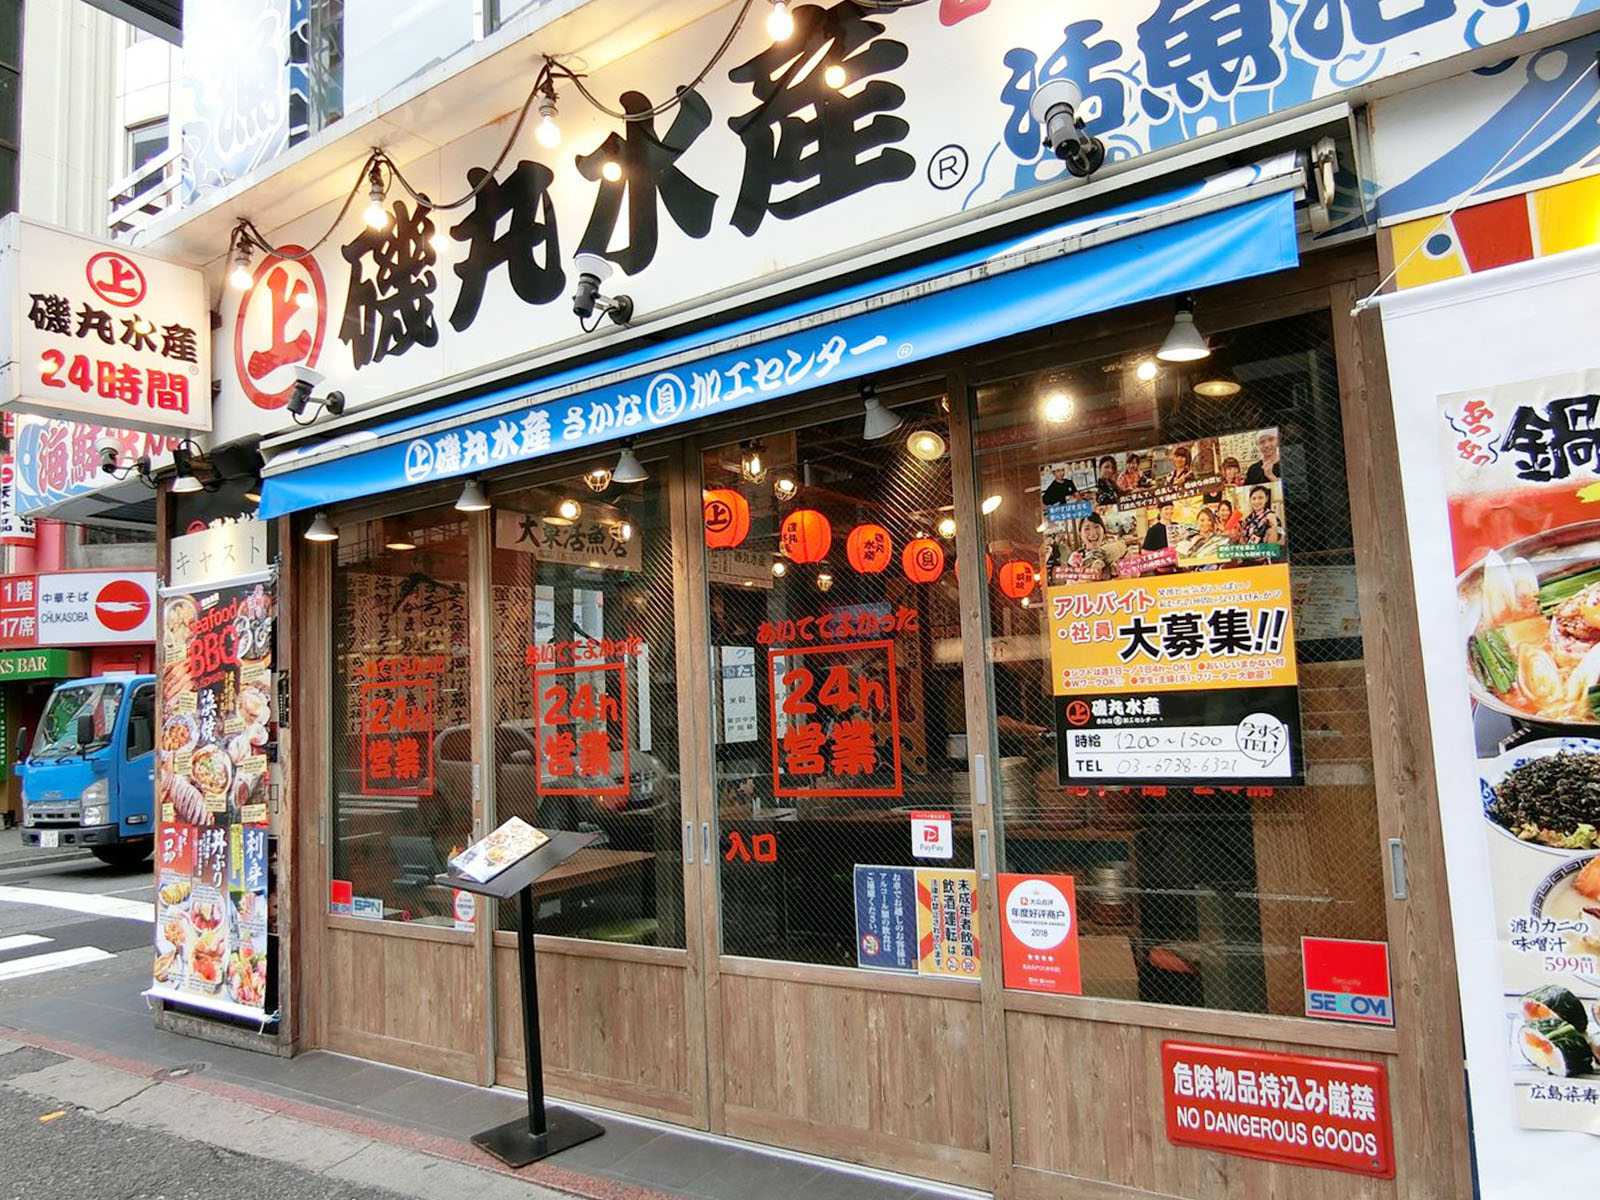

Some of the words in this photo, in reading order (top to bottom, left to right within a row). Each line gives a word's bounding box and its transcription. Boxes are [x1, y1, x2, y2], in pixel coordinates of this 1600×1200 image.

[339, 3, 917, 371] 磯丸水産
[29, 292, 199, 364] 磯丸水産
[41, 349, 190, 415] 24時間
[4, 580, 33, 602] 1階
[42, 591, 89, 604] 中華そば
[1054, 590, 1156, 619] アルバイト
[1, 616, 35, 638] 17席
[188, 596, 238, 635] Seafood
[756, 605, 920, 645] あいててよかった
[1118, 609, 1286, 661] 大募集!!
[17, 656, 47, 673] BAR
[189, 626, 241, 678] BBQ
[1091, 697, 1160, 716] 磯丸水産
[1074, 735, 1101, 748] 時給
[1242, 723, 1282, 741] 今すぐ
[367, 738, 421, 780] 営業
[544, 733, 612, 778] 営業
[783, 720, 878, 777] 営業
[1076, 760, 1103, 772] TEL
[246, 829, 264, 889] 刺身
[725, 831, 779, 863] 入口
[920, 844, 944, 853] PayPay
[354, 899, 381, 914] SPN
[943, 879, 958, 955] 飲酒運転は
[957, 879, 974, 957] 未成年者飲酒
[1011, 908, 1065, 920] 年度好评商户
[1031, 929, 1048, 937] 2018
[1510, 917, 1589, 934] 渡りカニの
[1511, 938, 1567, 954] 味噌汁
[1544, 956, 1594, 974] 599円
[1173, 1061, 1376, 1121] 危険物品持込み厳禁
[1176, 1105, 1200, 1129] NO
[1204, 1110, 1308, 1146] DANGEROUS
[1312, 1125, 1378, 1156] GOODS
